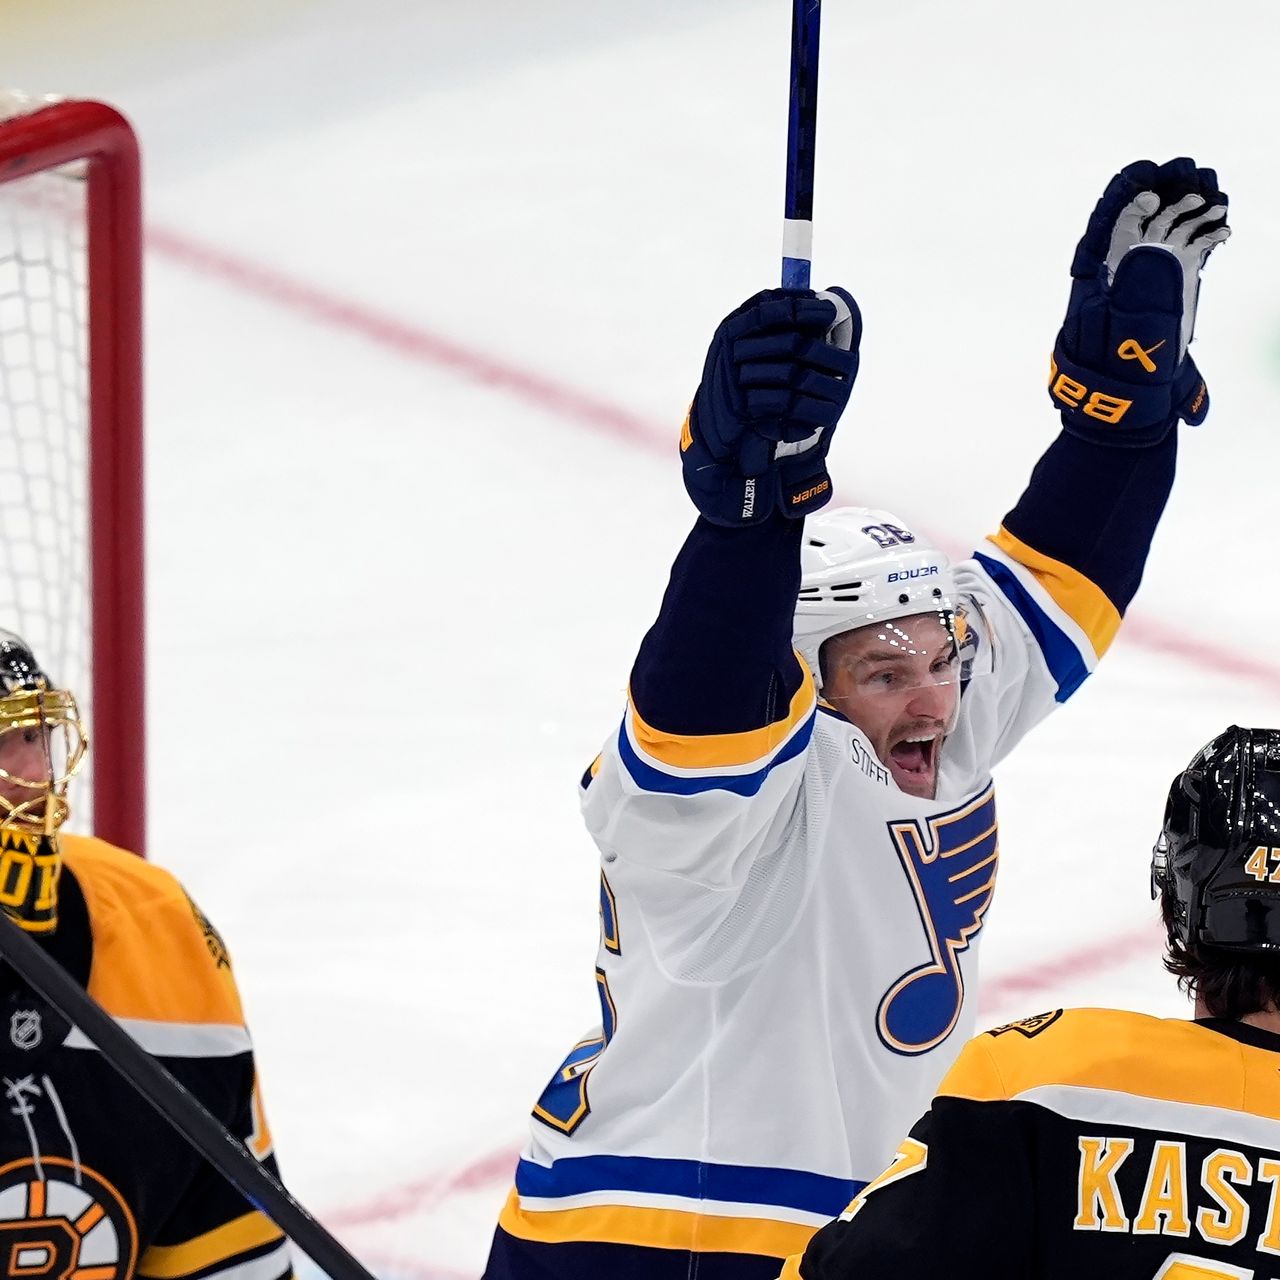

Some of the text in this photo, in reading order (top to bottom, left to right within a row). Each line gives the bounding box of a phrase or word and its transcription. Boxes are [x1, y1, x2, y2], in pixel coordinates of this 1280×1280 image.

[742, 478, 756, 519] WALKER
[791, 480, 829, 505] BAUER
[886, 565, 939, 583] BAUER
